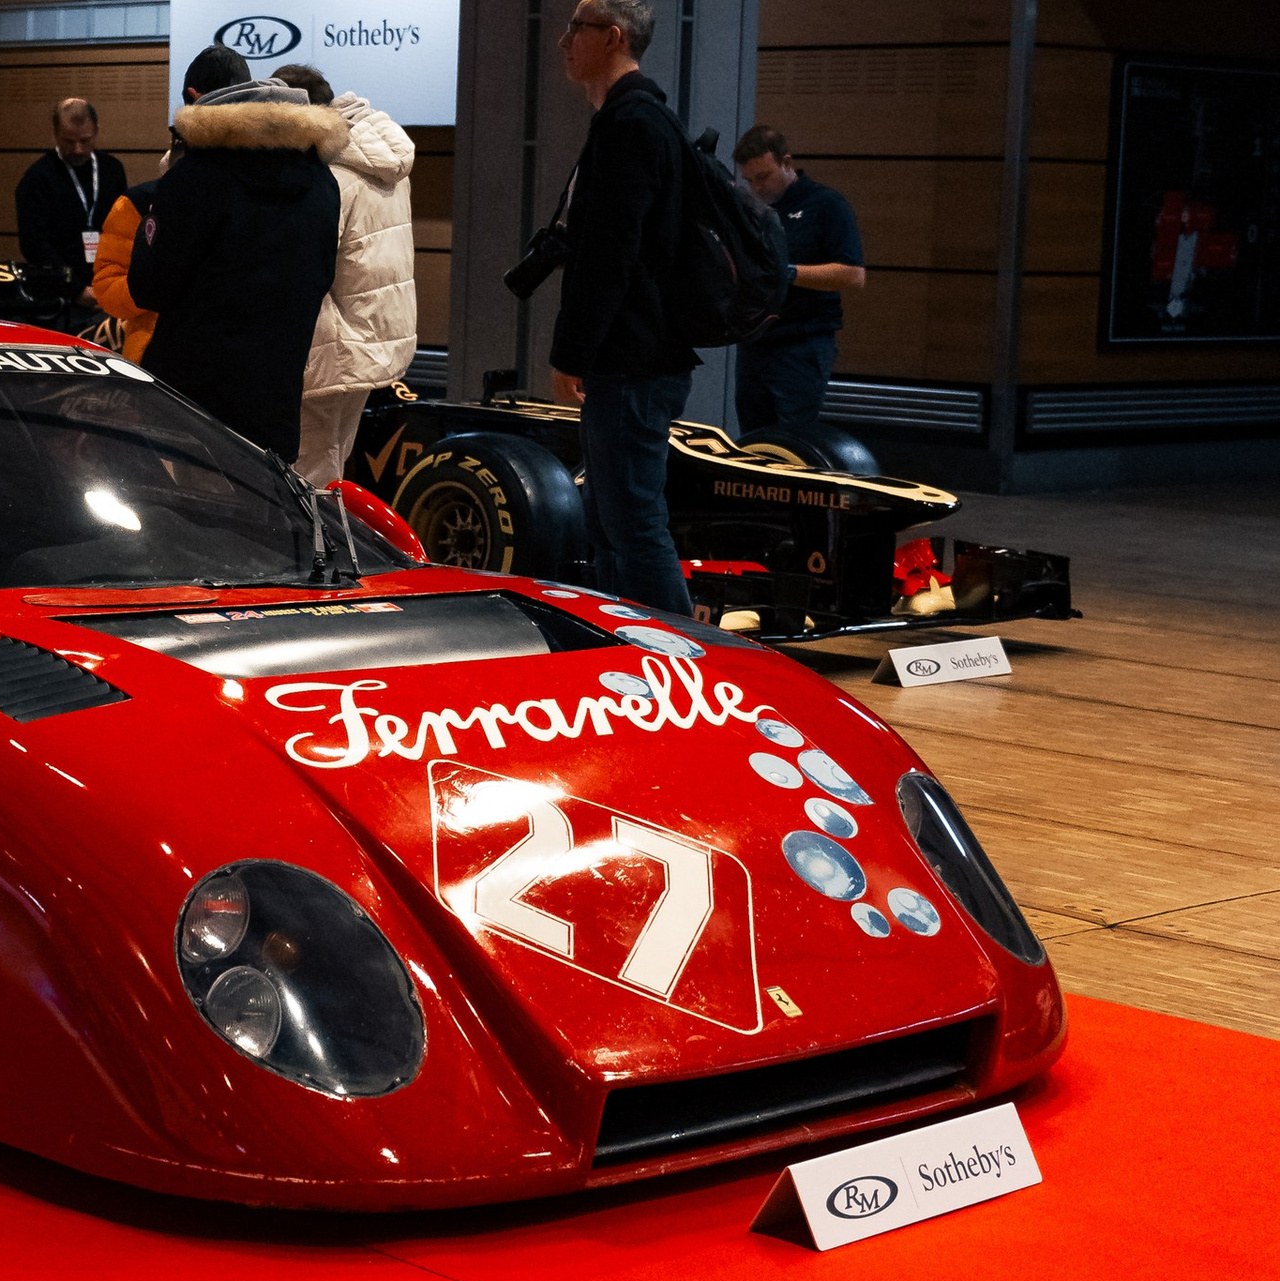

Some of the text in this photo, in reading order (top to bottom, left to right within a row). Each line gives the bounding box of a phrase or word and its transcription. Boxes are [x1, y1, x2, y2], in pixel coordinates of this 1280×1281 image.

[232, 19, 420, 55] RM Sotheby's
[433, 451, 454, 468] P
[458, 456, 515, 536] ZERO
[713, 480, 851, 510] RICHARD MILLE
[949, 652, 999, 670] Sotheby's
[265, 656, 776, 767] Ferrarelle
[465, 781, 716, 1002] 27
[843, 1145, 1017, 1213] RM Sotheby's
